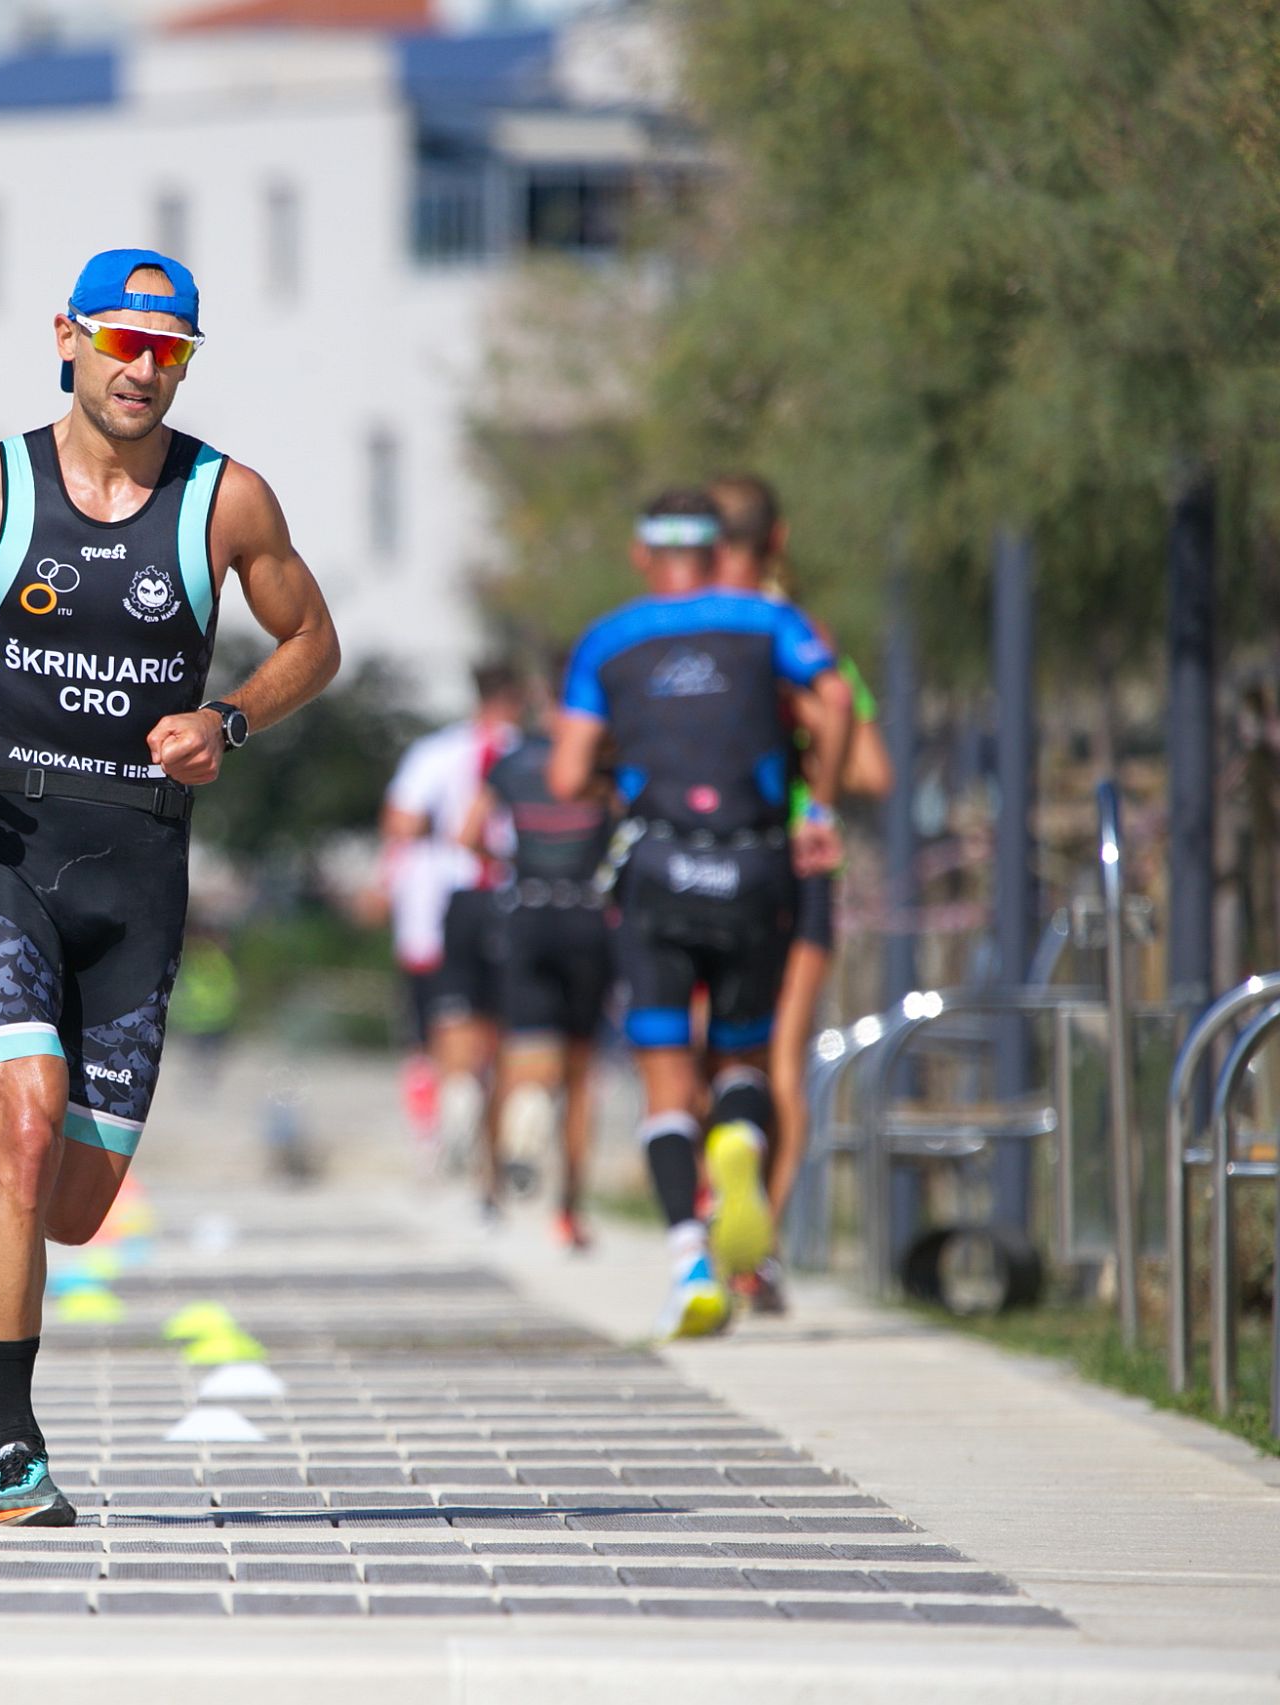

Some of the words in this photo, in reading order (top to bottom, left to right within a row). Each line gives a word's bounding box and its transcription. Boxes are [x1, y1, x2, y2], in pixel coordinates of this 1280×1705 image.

[81, 543, 127, 562] quest
[57, 607, 73, 616] ITU
[5, 637, 186, 684] ŠKRINJARIĆ
[59, 685, 131, 718] CRO
[8, 746, 117, 777] AVIOKARTE
[85, 1064, 133, 1086] quest
